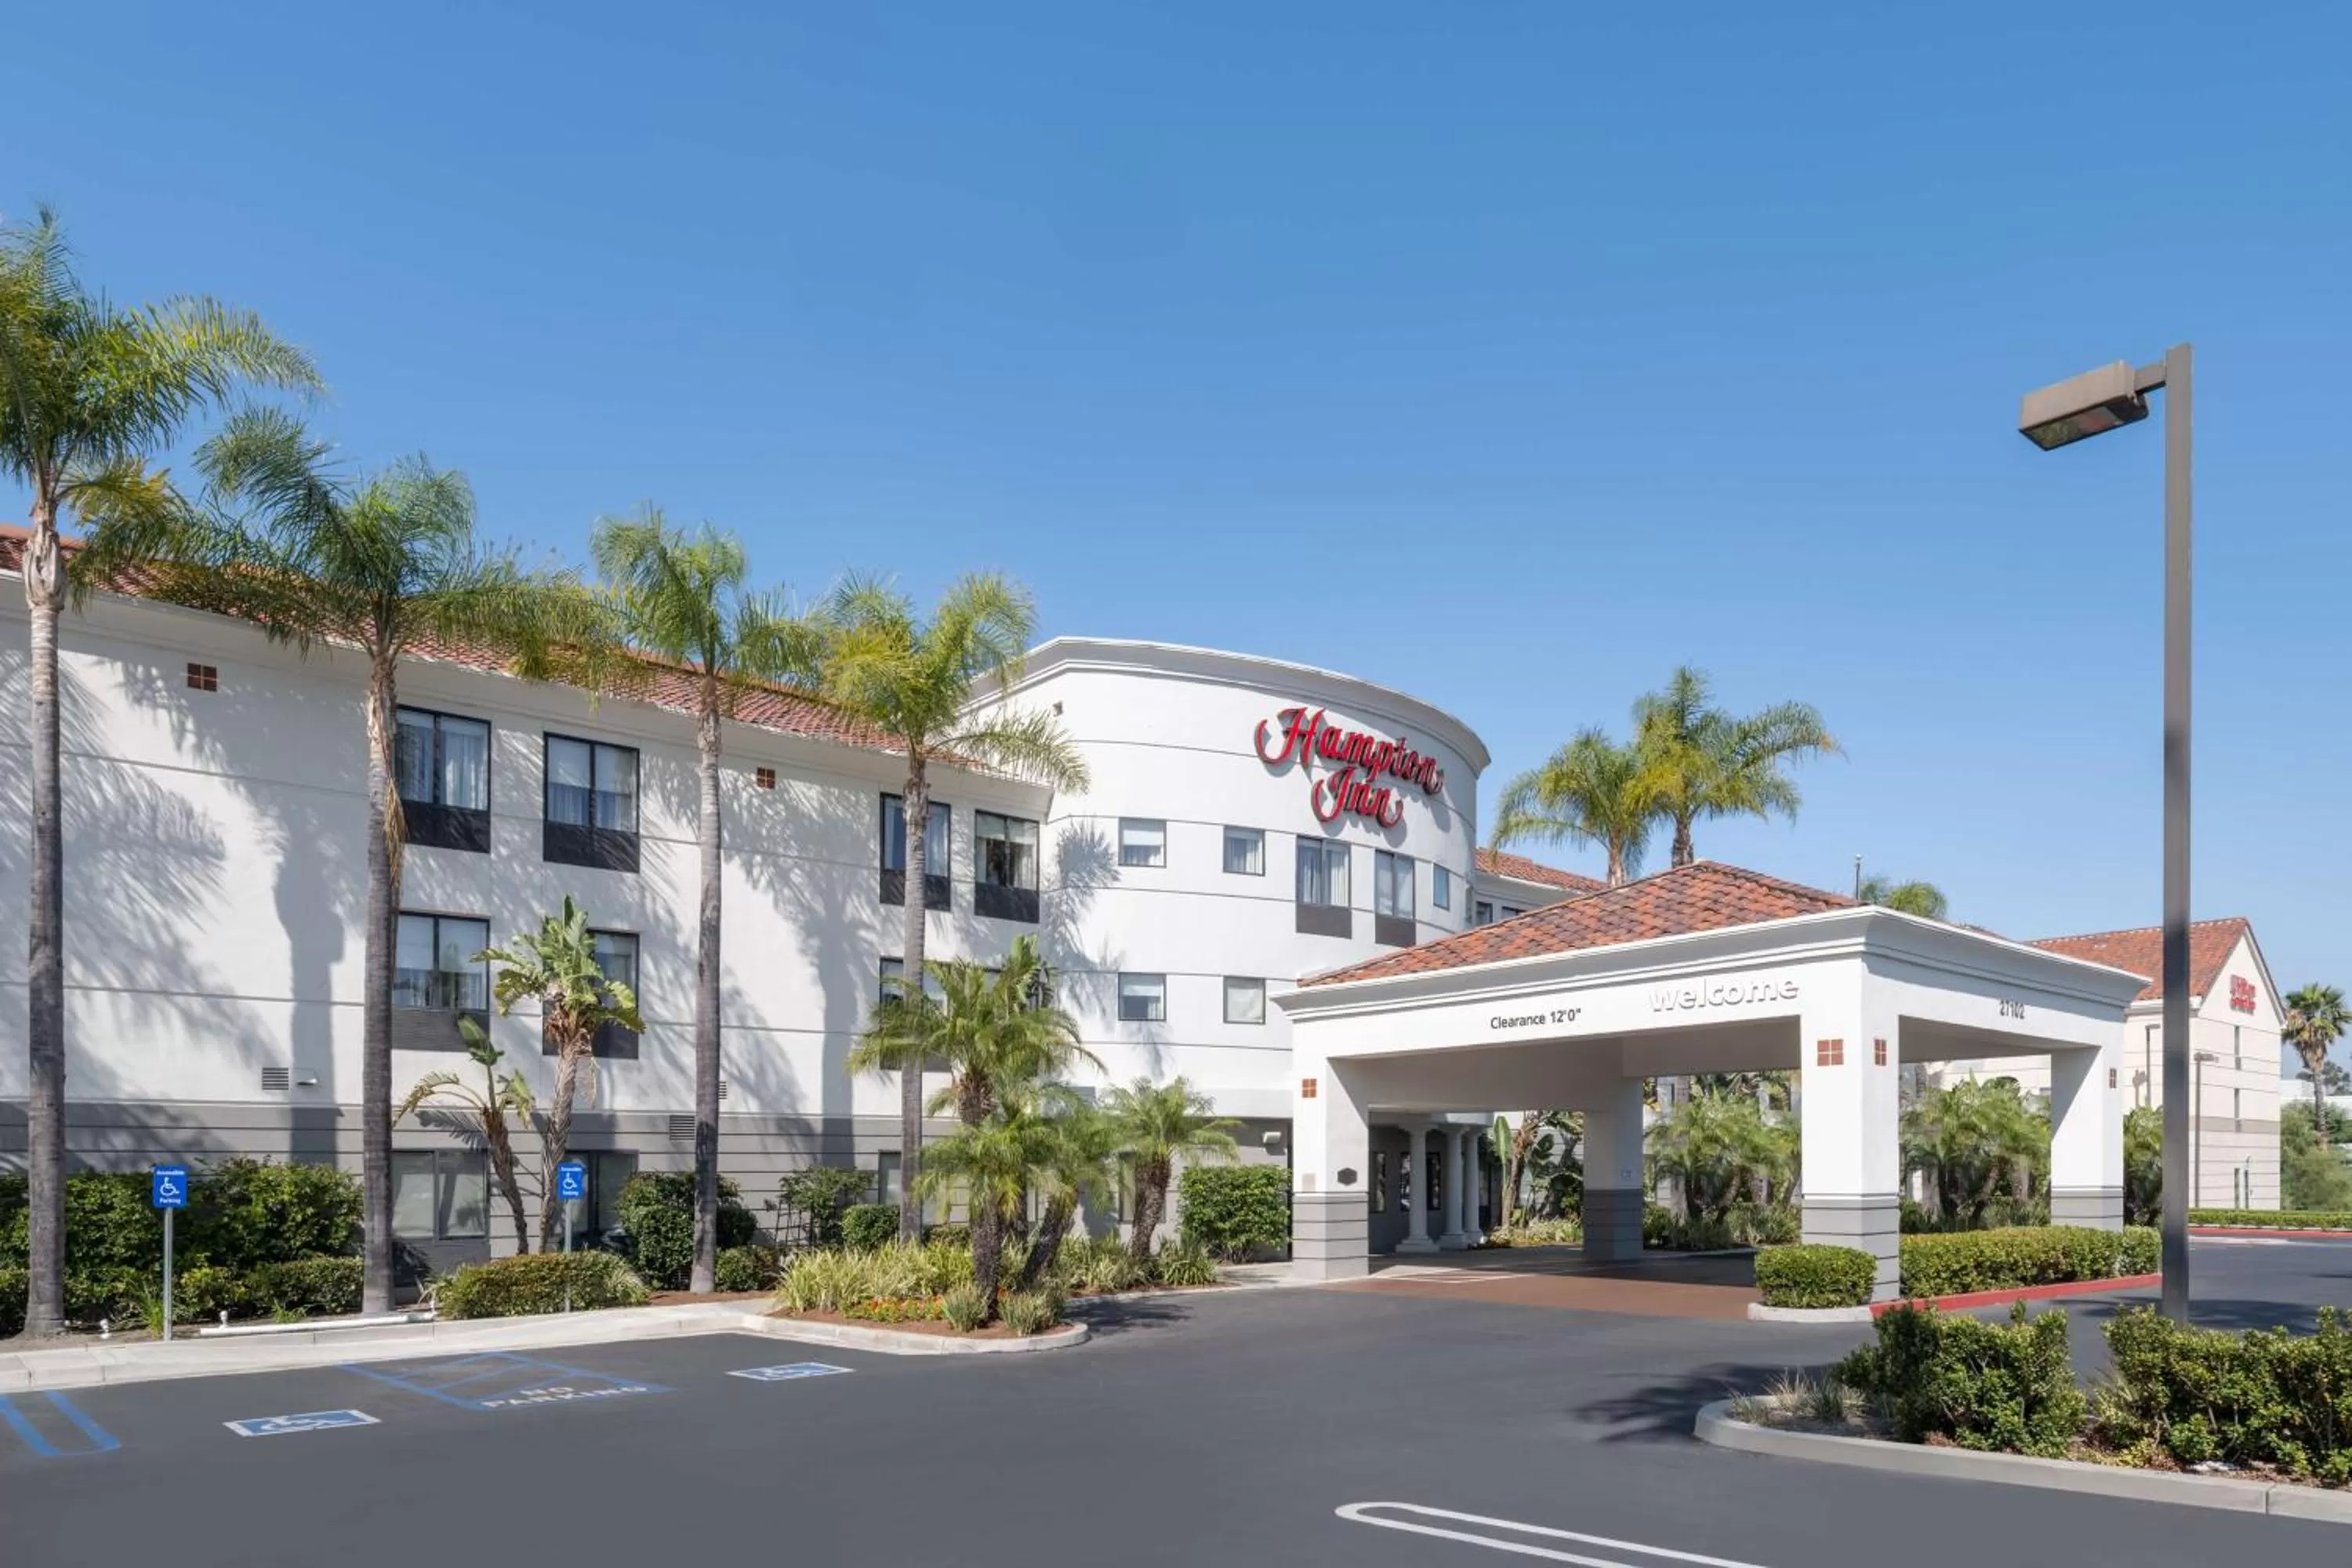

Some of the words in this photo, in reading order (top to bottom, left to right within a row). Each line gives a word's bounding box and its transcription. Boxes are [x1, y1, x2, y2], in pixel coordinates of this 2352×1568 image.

[1254, 706, 1444, 795] Hampton
[1311, 766, 1403, 828] Inn
[1650, 978, 1799, 1012] welcome
[2000, 999, 2025, 1019] 27102
[1490, 1015, 1546, 1029] Clearance
